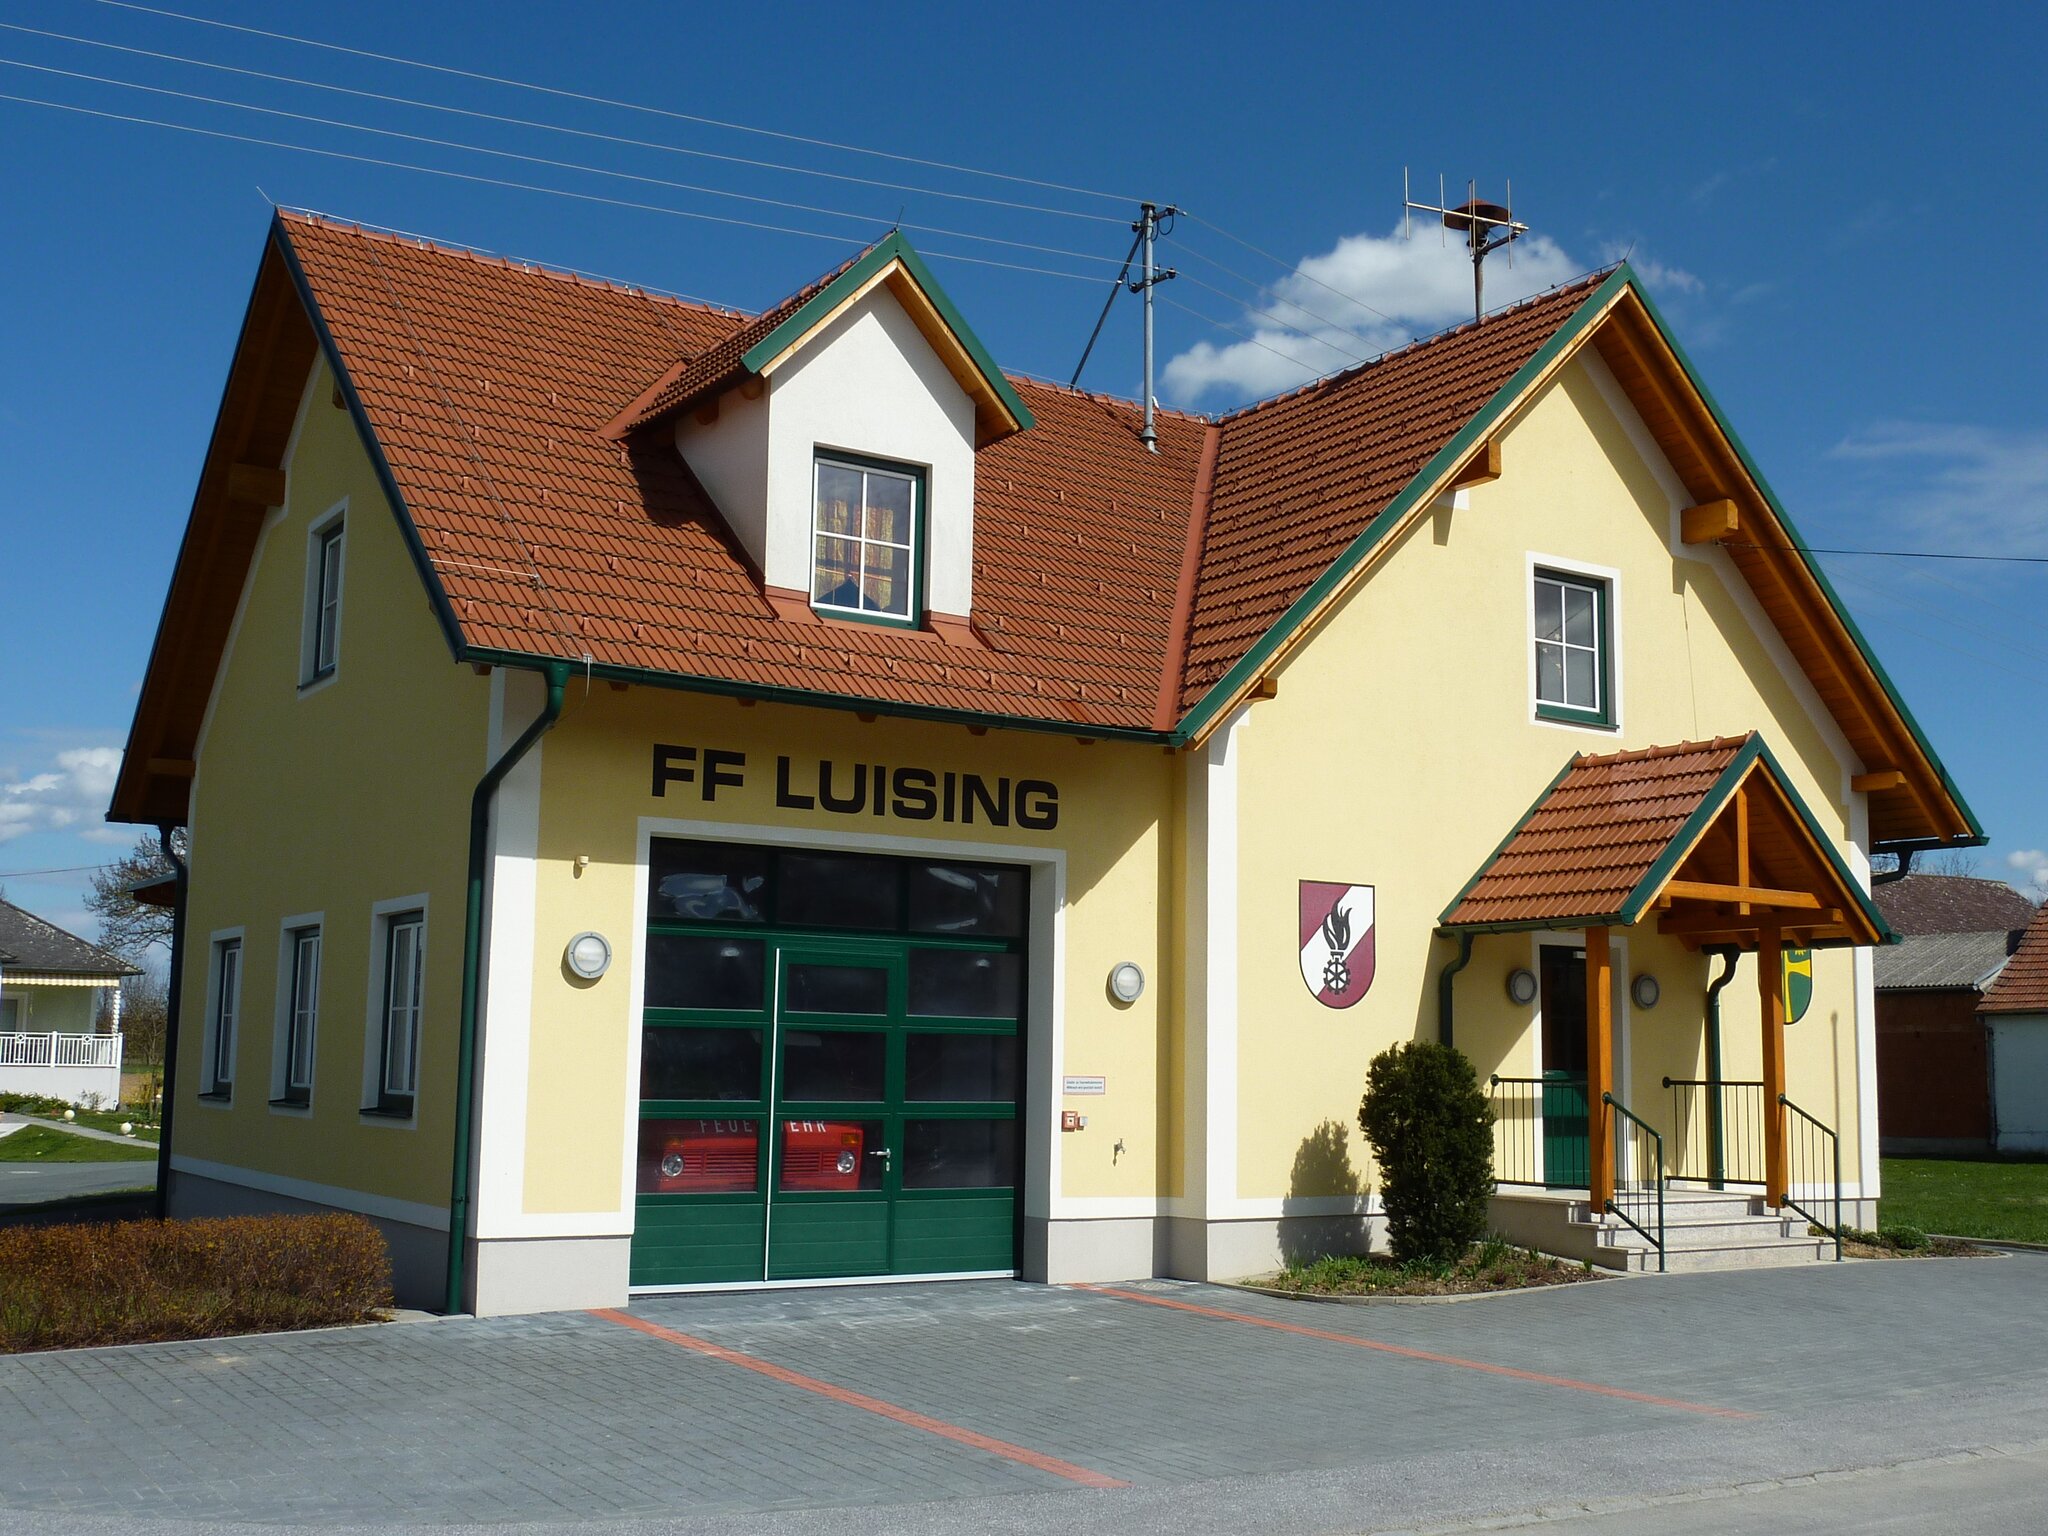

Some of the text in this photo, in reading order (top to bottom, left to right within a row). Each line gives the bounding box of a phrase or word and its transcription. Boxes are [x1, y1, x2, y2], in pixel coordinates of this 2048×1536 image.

[651, 743, 1059, 831] FF LUISING
[699, 1119, 827, 1133] FEUEEHR
